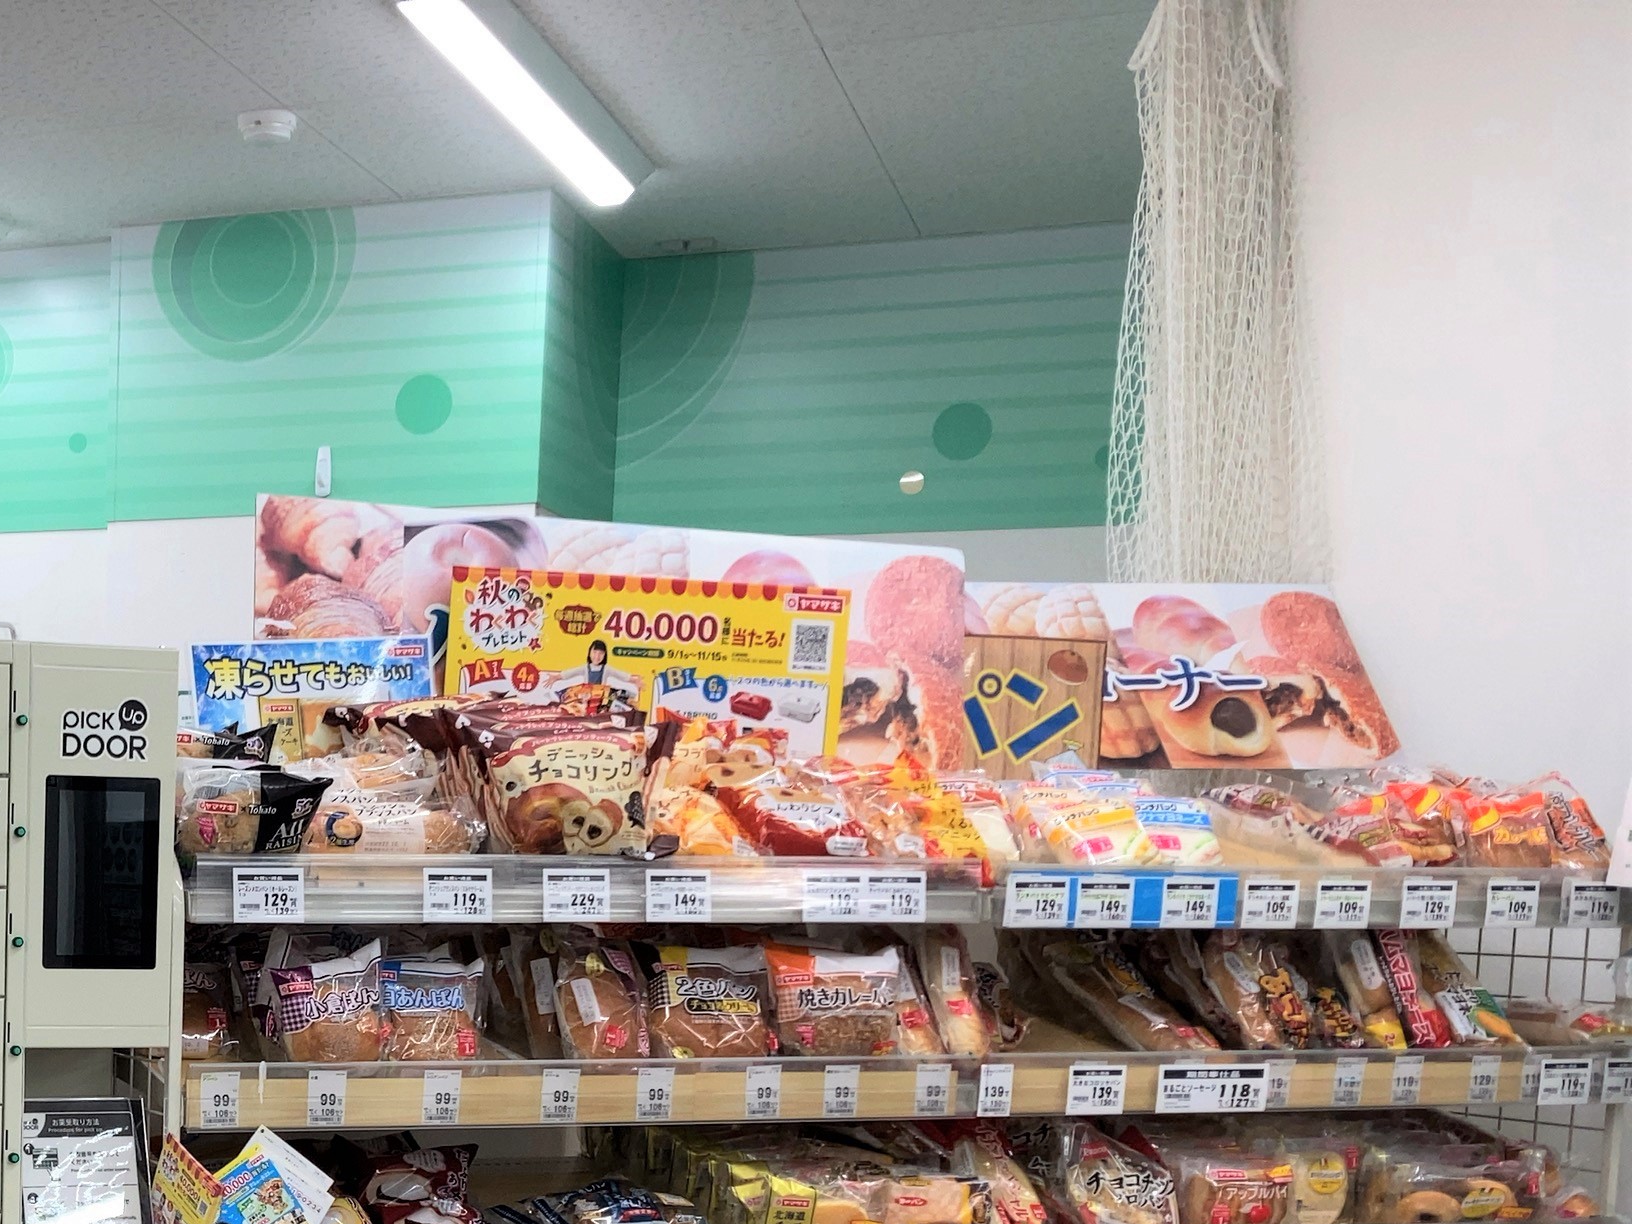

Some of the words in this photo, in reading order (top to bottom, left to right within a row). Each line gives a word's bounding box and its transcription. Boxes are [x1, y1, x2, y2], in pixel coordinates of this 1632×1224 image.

[476, 576, 521, 605] 秋の
[799, 599, 842, 612] ヤマザキ
[469, 603, 539, 633] わくわく
[604, 610, 718, 643] 40,000
[481, 633, 528, 648] プレゼント
[731, 628, 785, 648] 当たる!
[393, 647, 422, 656] ヤマザキ
[668, 667, 685, 688] B
[62, 709, 115, 732] PICK
[963, 670, 1083, 762] パン
[61, 732, 147, 761] DOOR
[546, 747, 615, 761] デニッシュ
[528, 760, 635, 784] チョコリング
[207, 802, 238, 813] ヤマザキ
[248, 804, 277, 816] Tohato
[288, 982, 313, 994] ヤマザキ
[675, 975, 758, 1000] 2色パン
[383, 986, 465, 1011] 白あんぱん
[52, 1118, 101, 1127] お薬受取り方法
[1087, 1168, 1176, 1200] チョコチップ
[1221, 1184, 1288, 1201] アップルパイ
[774, 1209, 805, 1222] 北海道
